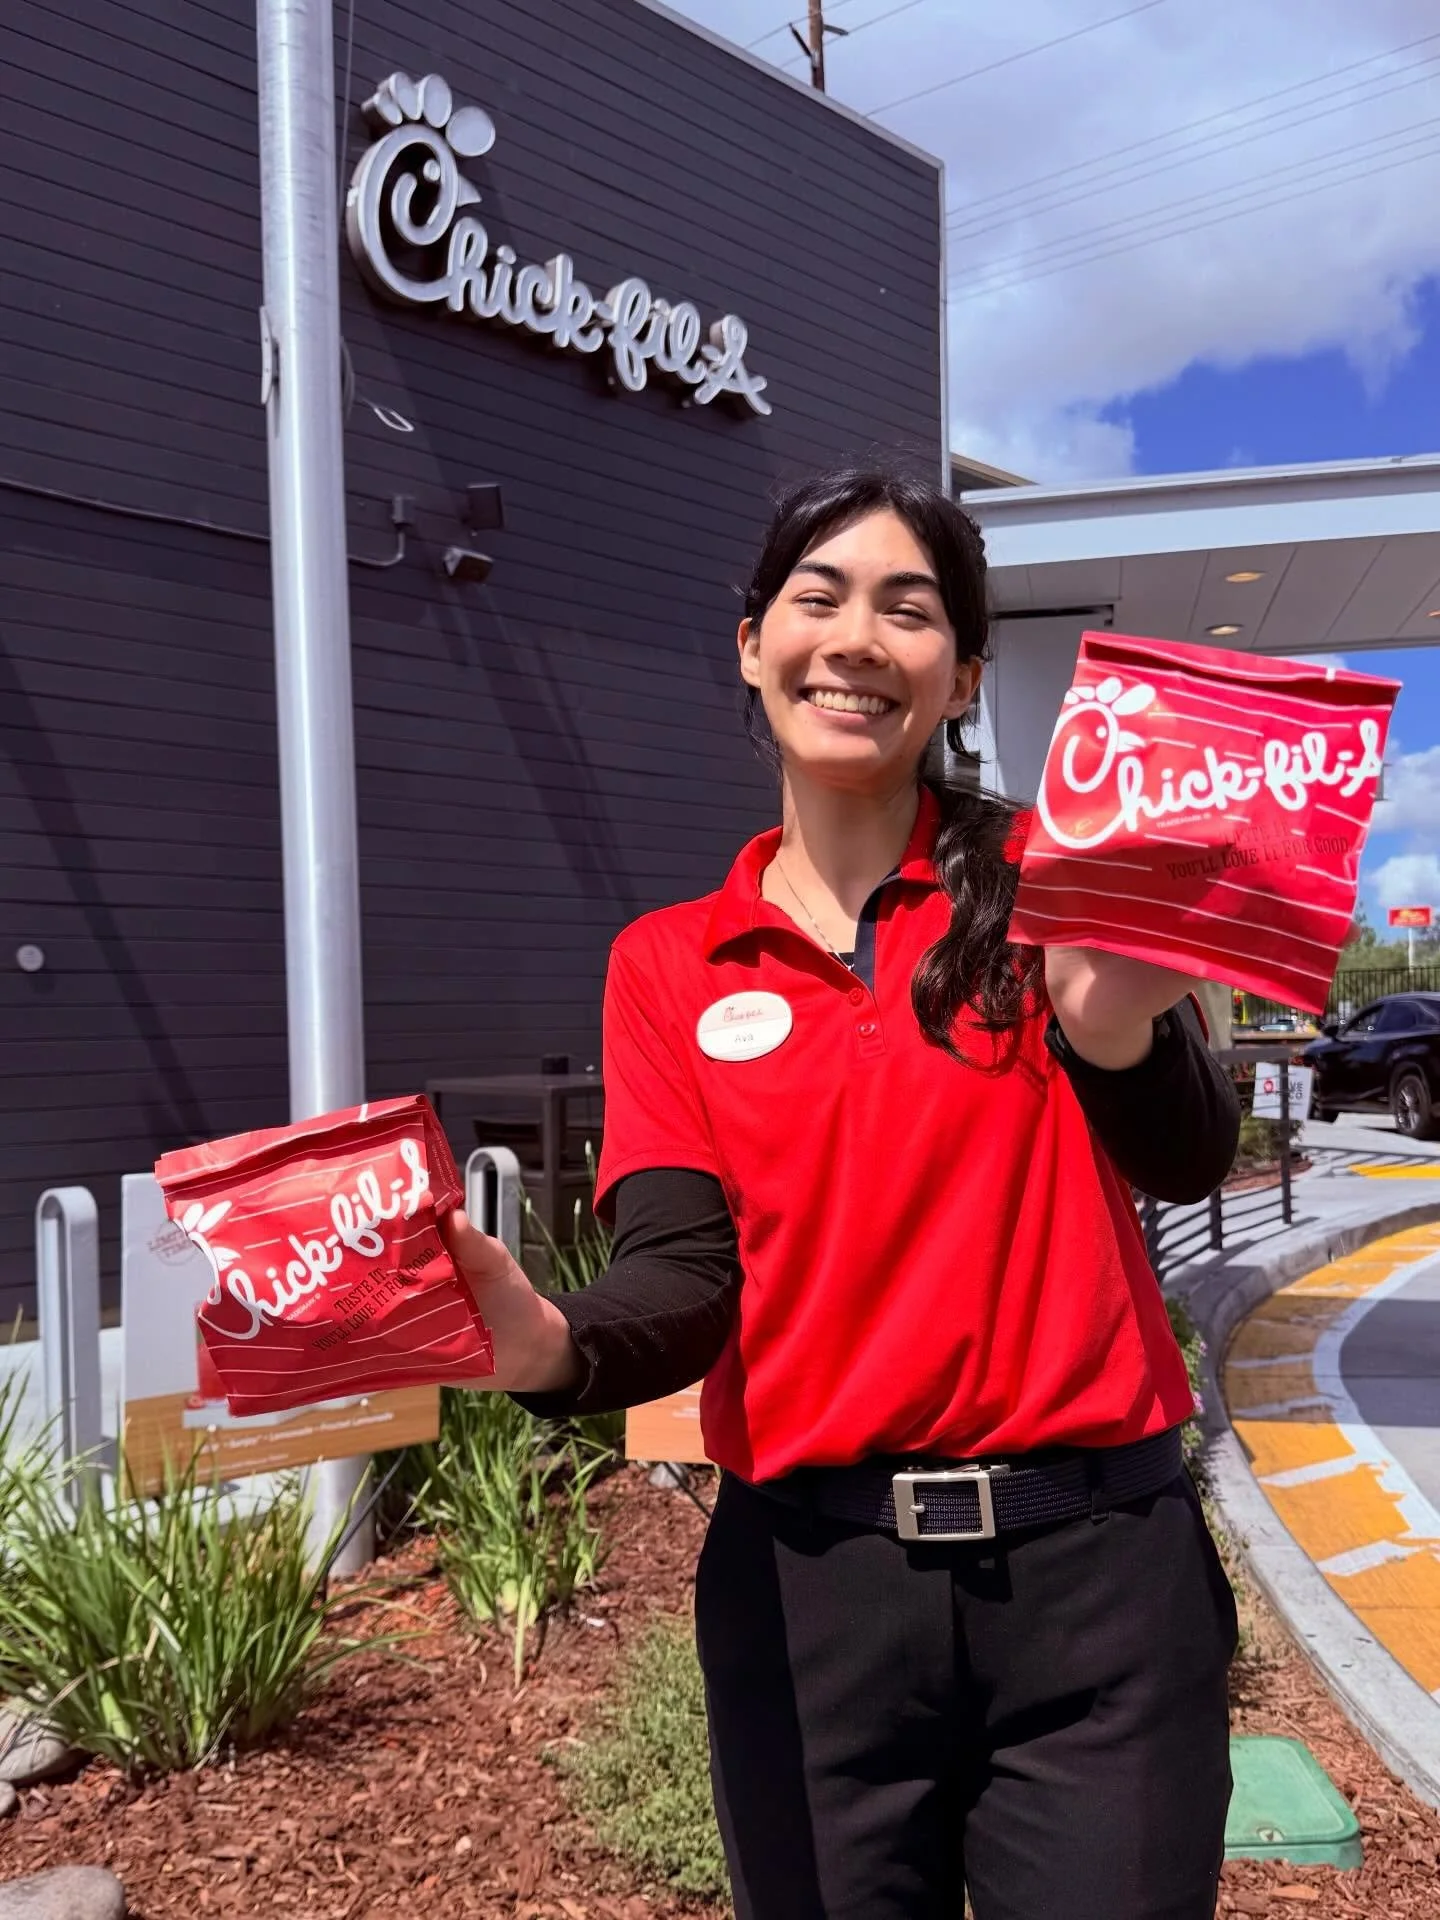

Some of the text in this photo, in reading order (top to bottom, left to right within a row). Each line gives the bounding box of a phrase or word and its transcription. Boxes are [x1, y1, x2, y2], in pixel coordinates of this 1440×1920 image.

[346, 120, 773, 416] Chick-fil-A
[1037, 702, 1382, 849] Chick-fil-A
[1166, 855, 1218, 881] YOU'LL
[1222, 847, 1260, 869] LOVE
[1264, 842, 1279, 862] IT
[1282, 838, 1312, 859] FOR
[333, 1279, 374, 1315] TASTE
[345, 1306, 377, 1331] LOVE
[371, 1289, 391, 1308] IT
